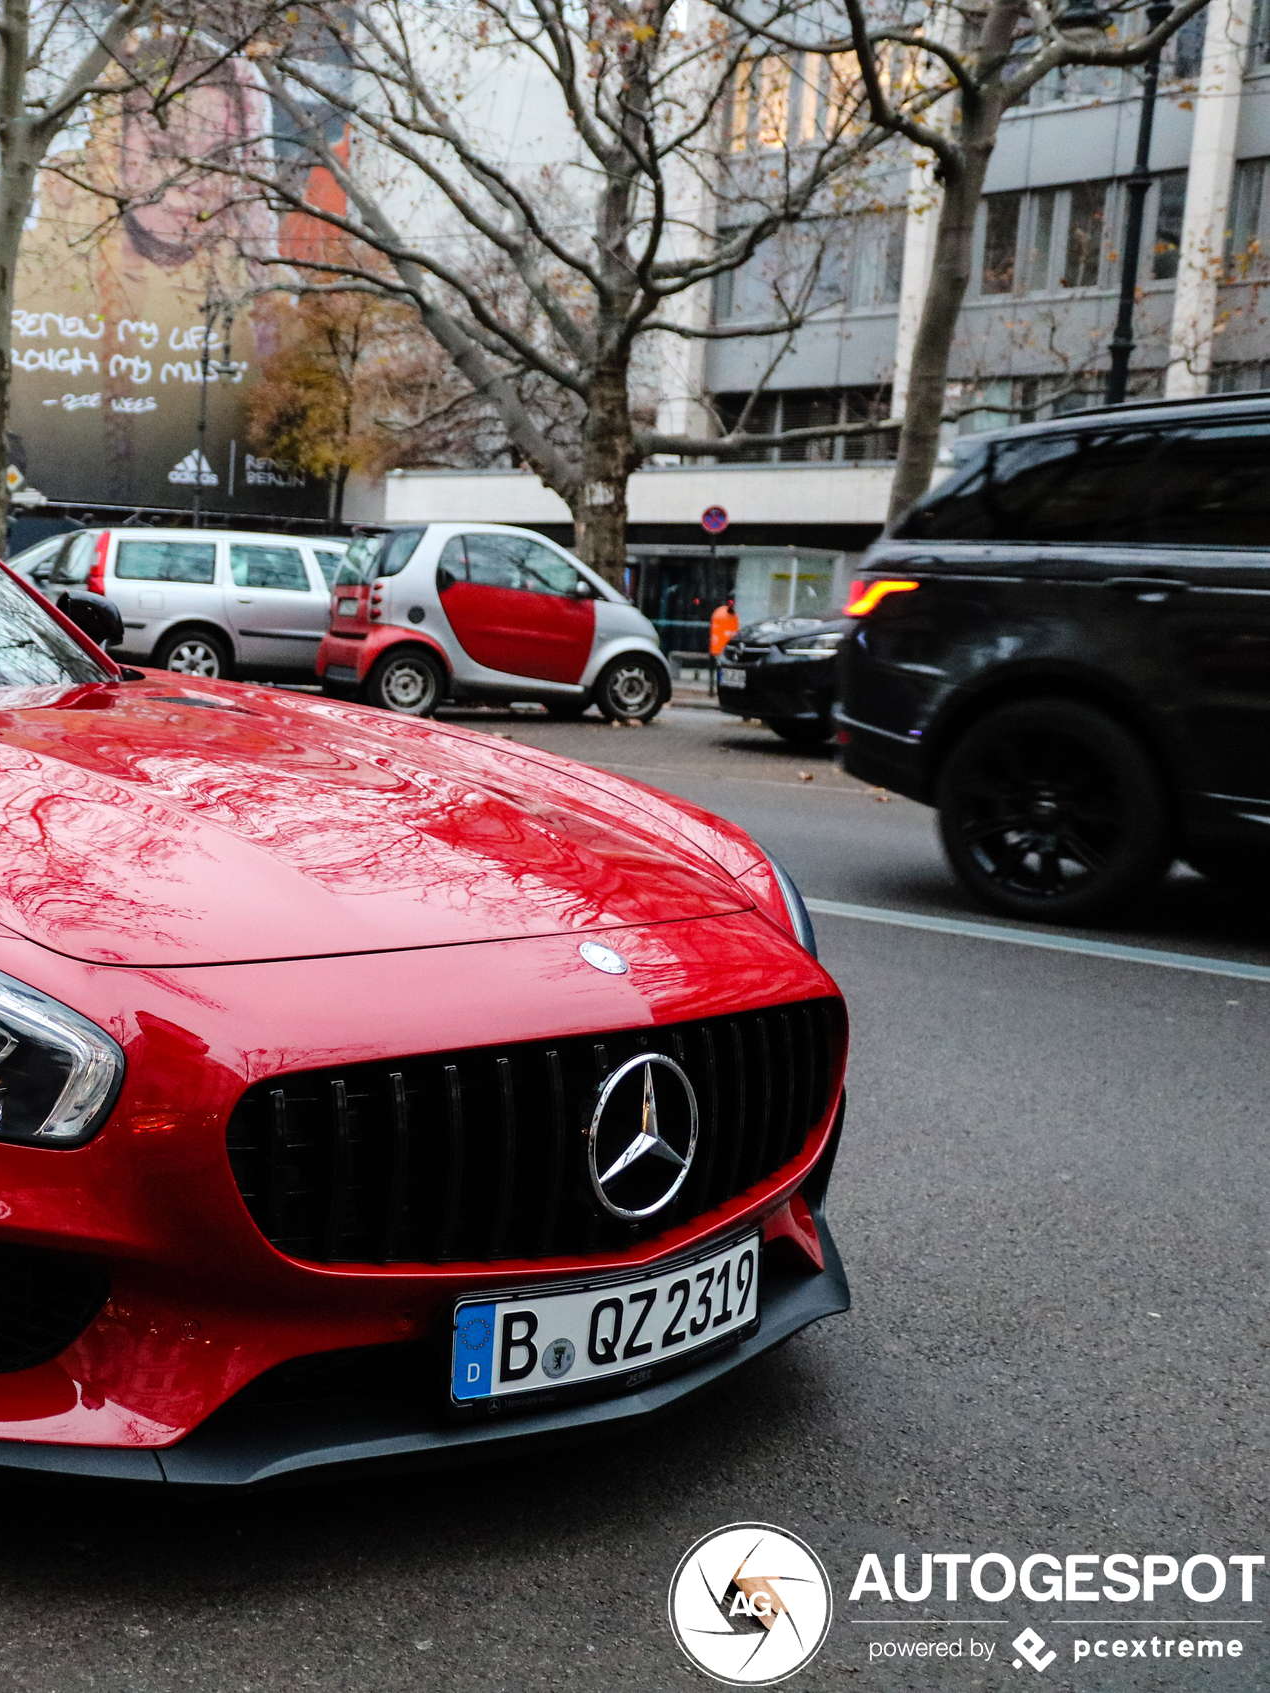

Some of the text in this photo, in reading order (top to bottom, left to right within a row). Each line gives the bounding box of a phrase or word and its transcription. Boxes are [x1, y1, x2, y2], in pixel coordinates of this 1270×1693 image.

[467, 1363, 480, 1383] D
[499, 1310, 539, 1383] B
[587, 1287, 658, 1366] QZ
[661, 1249, 755, 1349] 2319
